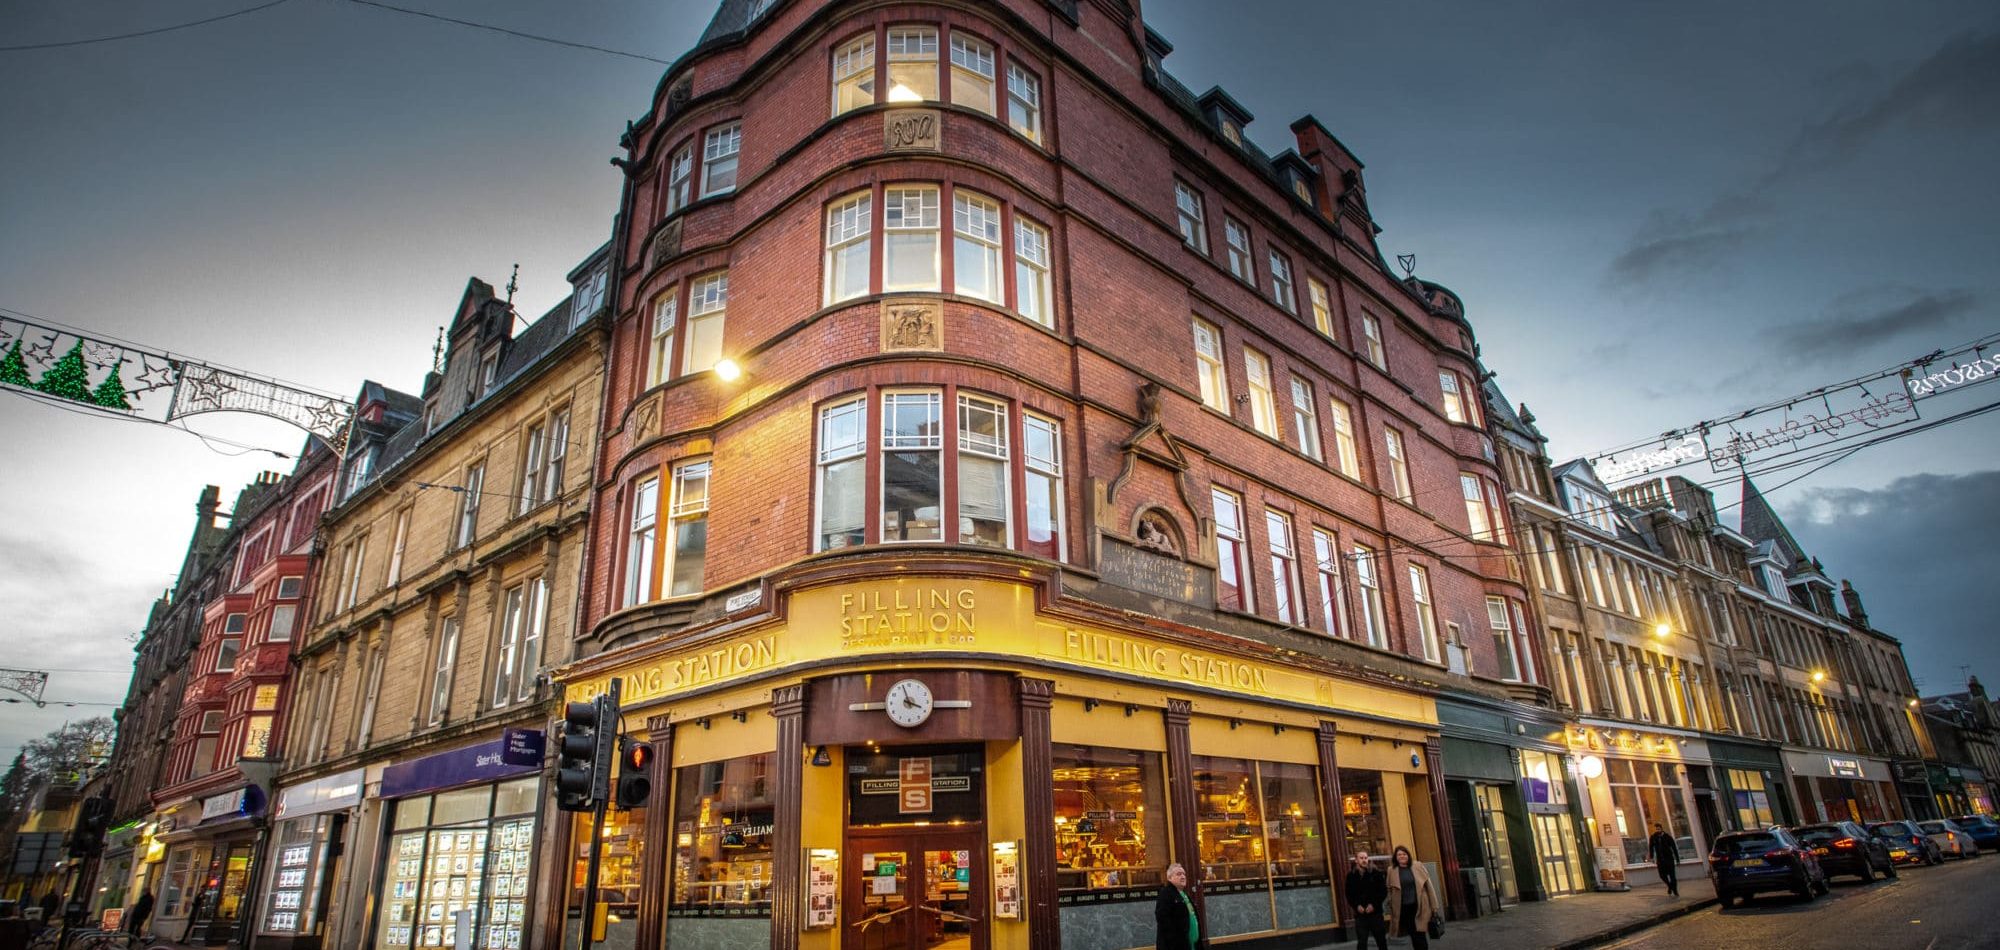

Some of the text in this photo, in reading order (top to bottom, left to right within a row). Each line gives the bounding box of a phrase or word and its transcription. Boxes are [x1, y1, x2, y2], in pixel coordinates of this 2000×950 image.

[840, 588, 976, 615] FILLING
[840, 611, 976, 638] STATION
[949, 635, 975, 645] BAR
[672, 635, 777, 687] STATION
[1064, 629, 1269, 692] FILLING STATION
[906, 763, 925, 780] F
[866, 781, 898, 789] FILLING
[905, 790, 926, 808] S
